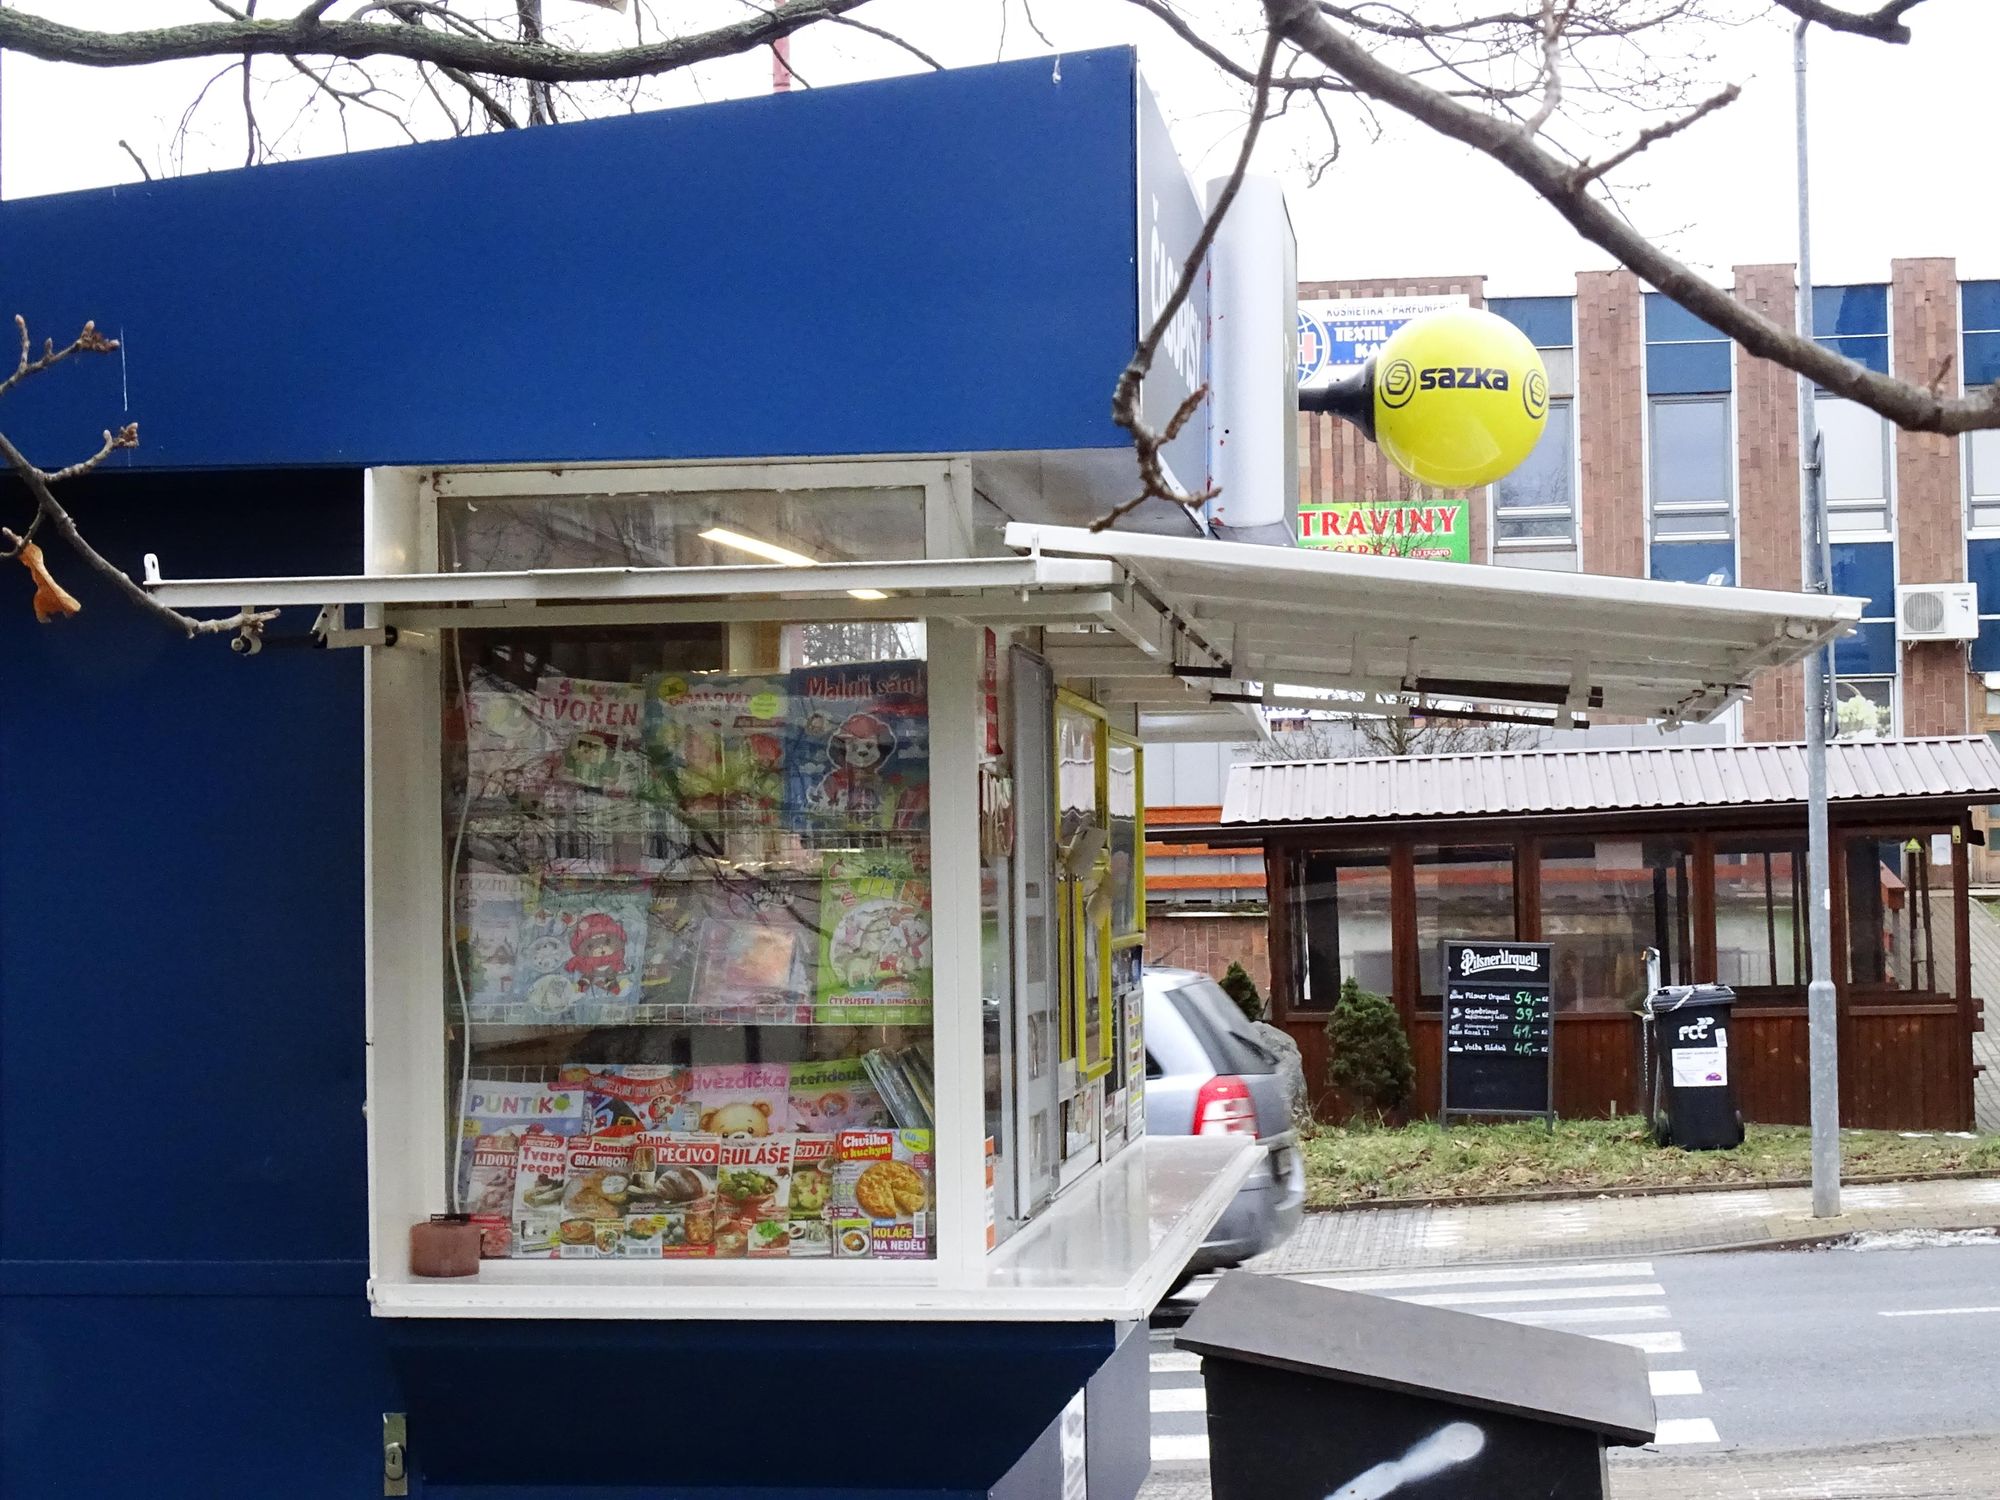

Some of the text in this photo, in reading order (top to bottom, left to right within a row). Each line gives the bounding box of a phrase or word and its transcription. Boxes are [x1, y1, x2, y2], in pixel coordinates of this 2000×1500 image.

[1333, 326, 1388, 342] TEXTIL
[1460, 948, 1500, 977] Pilsner
[842, 1135, 888, 1148] Chvilka
[658, 1144, 714, 1163] PEČIVO
[721, 1142, 791, 1165] GULÁŠE
[873, 1226, 912, 1238] KOLÁČE
[873, 1241, 887, 1251] NA
